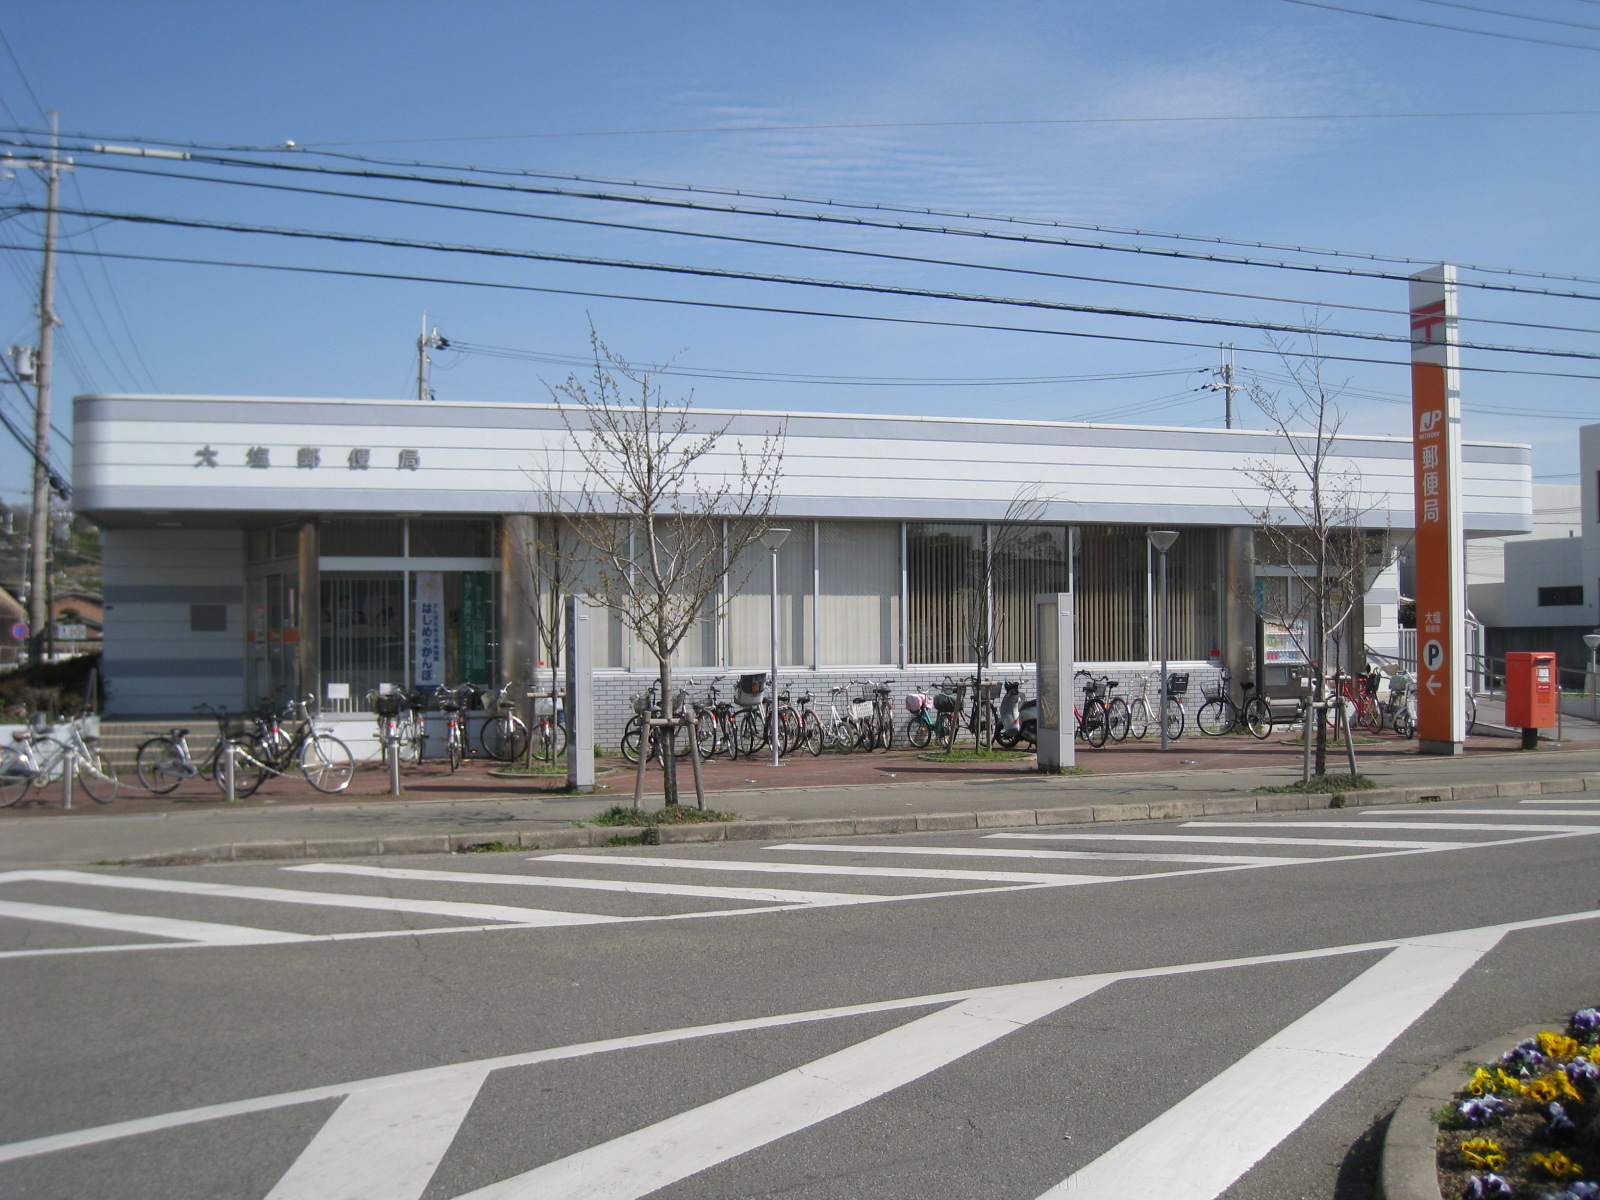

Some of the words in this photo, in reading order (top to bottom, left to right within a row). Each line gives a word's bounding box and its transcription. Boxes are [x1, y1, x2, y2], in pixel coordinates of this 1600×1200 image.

[1420, 410, 1442, 432] JP
[1419, 431, 1440, 440] NETWORK
[194, 444, 420, 471] 大塩郵便局
[1422, 444, 1439, 523] 郵便局
[1425, 611, 1441, 624] 大塩
[422, 603, 432, 681] はじめのかんぽ
[1428, 644, 1439, 666] P
